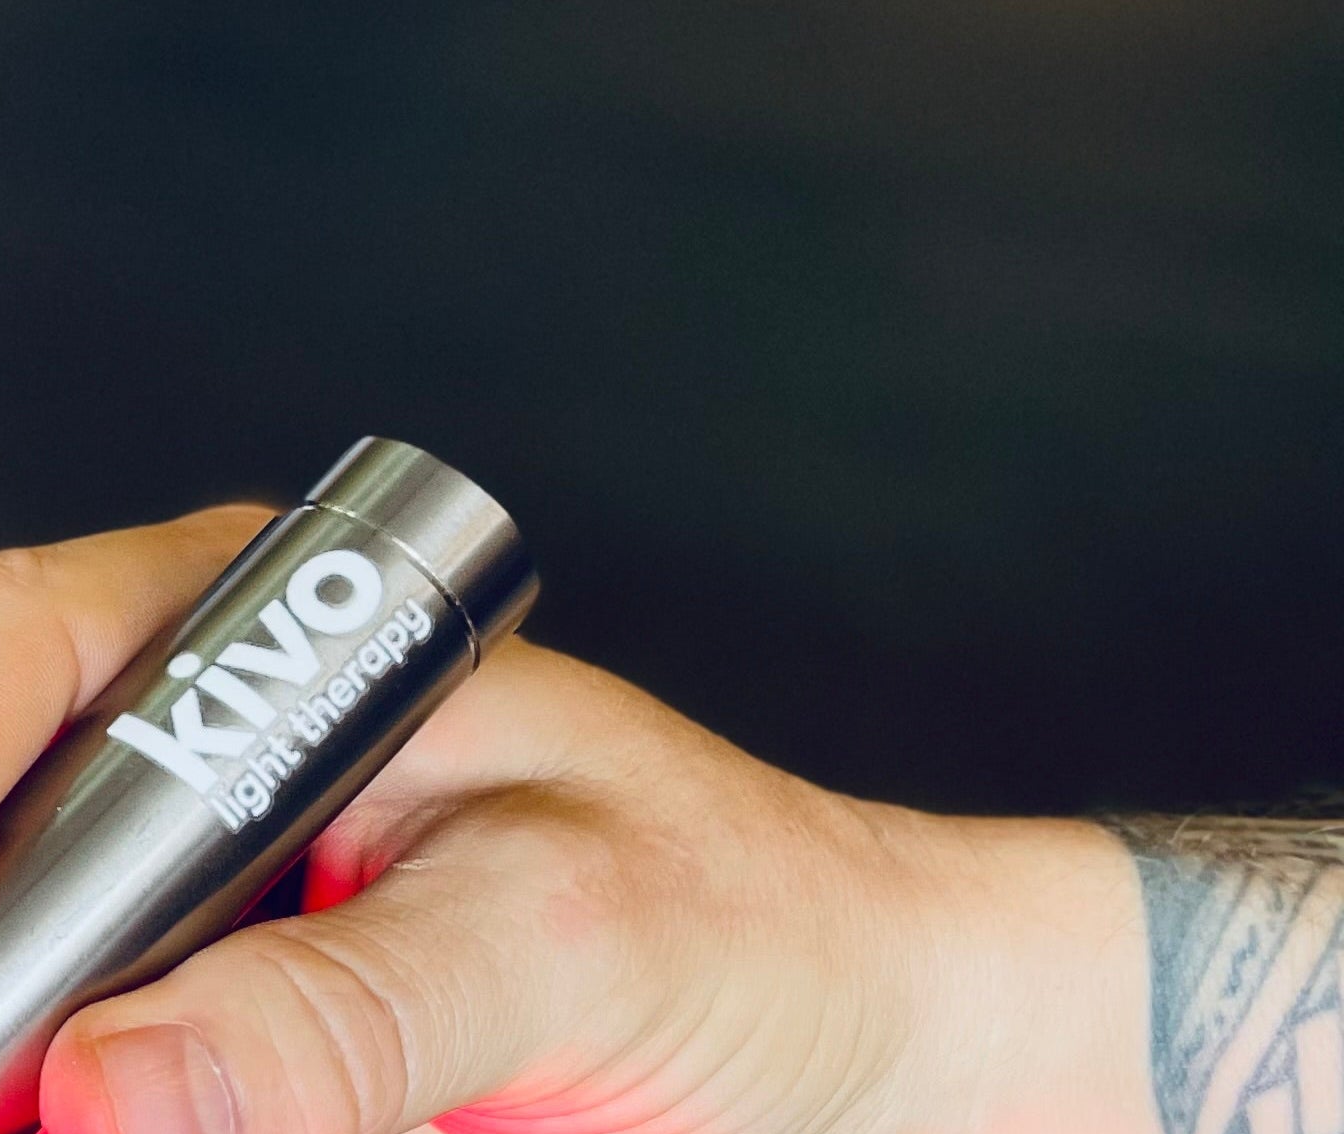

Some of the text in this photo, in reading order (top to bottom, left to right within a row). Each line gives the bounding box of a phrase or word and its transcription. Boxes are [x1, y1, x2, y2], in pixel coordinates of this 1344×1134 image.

[107, 549, 384, 791] kivo
[212, 598, 433, 831] light therapy
